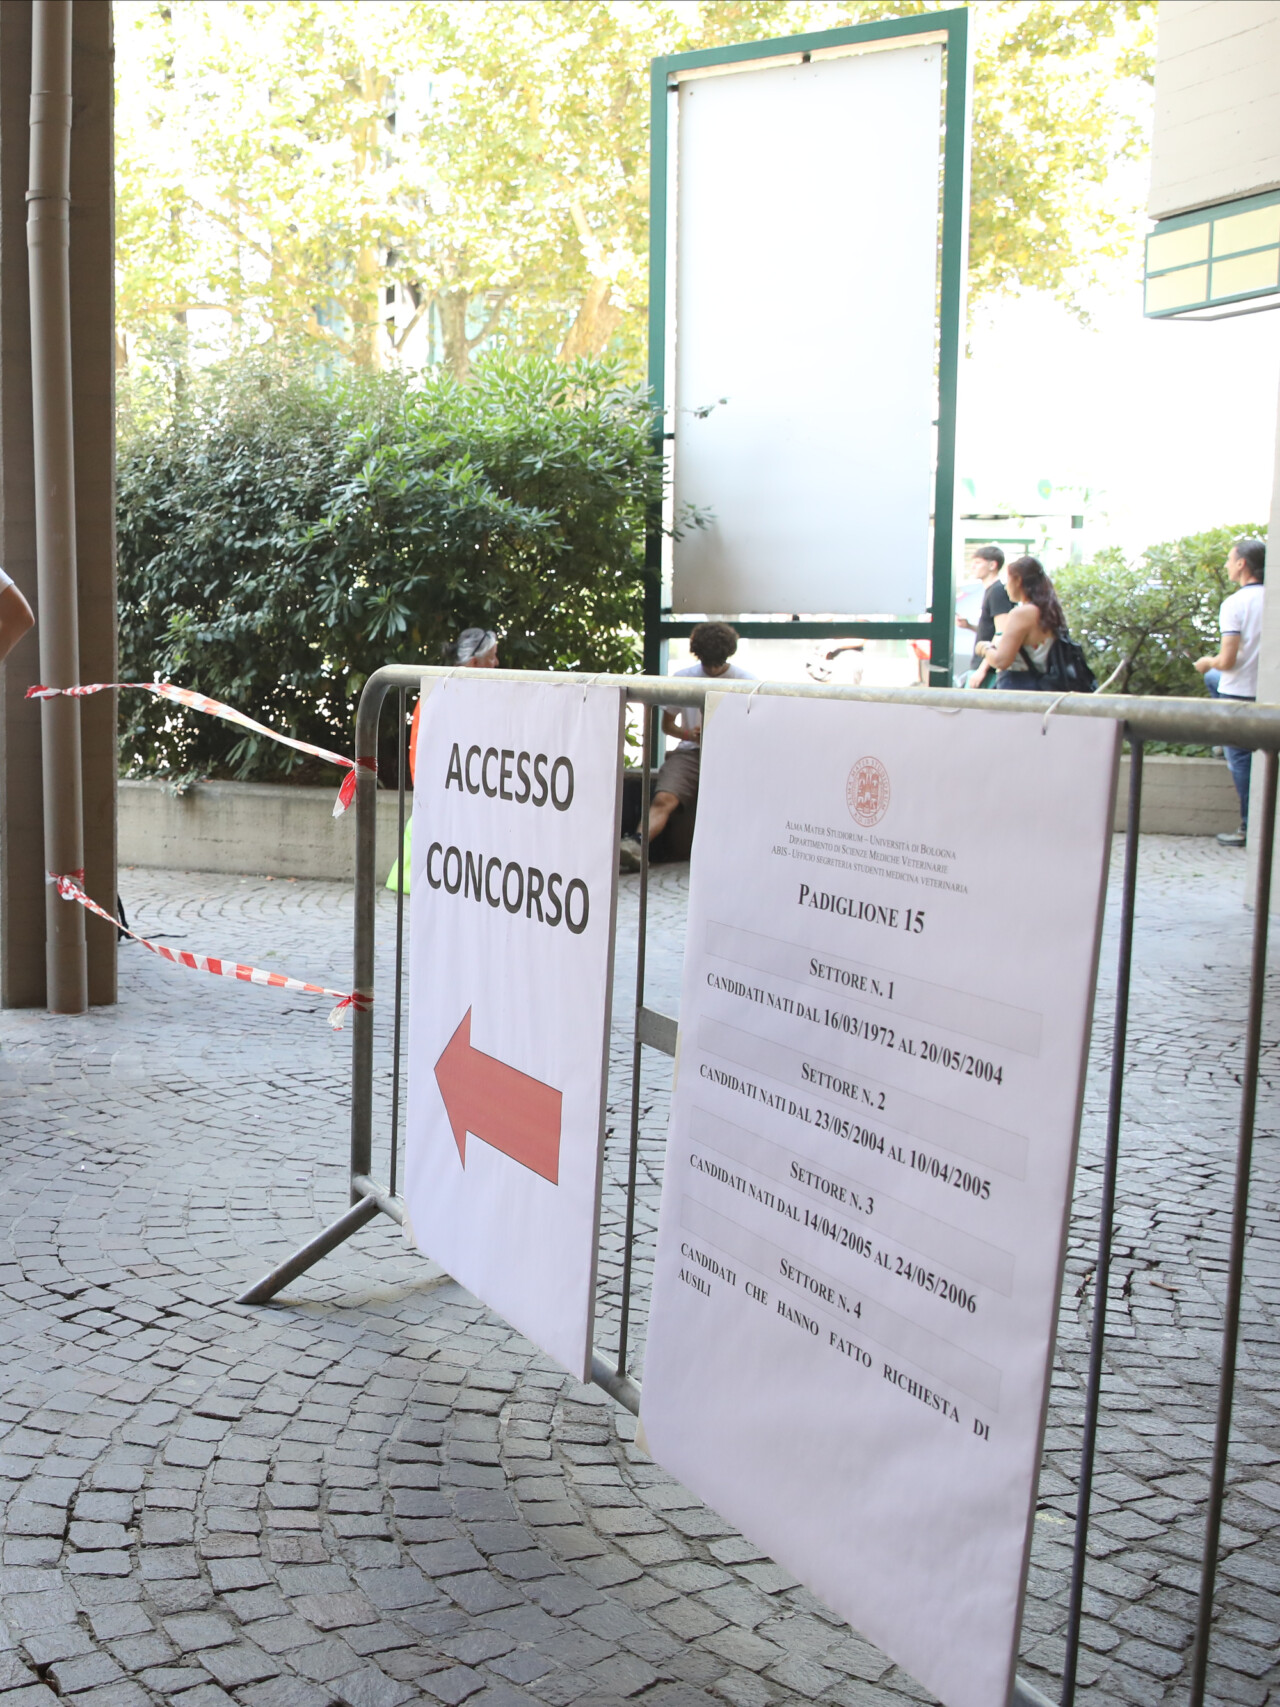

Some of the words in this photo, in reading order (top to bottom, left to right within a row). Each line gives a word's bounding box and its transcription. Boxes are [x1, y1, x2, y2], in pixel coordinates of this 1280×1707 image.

[445, 743, 574, 811] ACCESSO
[785, 821, 802, 831] ALMA
[804, 824, 825, 835] MATER
[827, 828, 863, 843] STUDIORUM
[870, 835, 909, 852] UNIVERSITÀ
[911, 844, 918, 853] DI
[920, 844, 956, 860] BOLOGNA
[789, 835, 833, 851] DIPARTIMENTO
[834, 845, 840, 853] DI
[841, 845, 867, 858] SCIENZE
[869, 850, 899, 864] MEDICHE
[901, 854, 948, 874] VETERINARIE
[427, 842, 589, 934] CONCORSO
[771, 846, 787, 856] ABIS
[792, 849, 815, 862] UFFICIO
[816, 856, 852, 870] SEGRETERIA
[854, 864, 884, 876] STUDENTI
[886, 870, 918, 884] MEDICINA
[921, 877, 968, 894] VETERINARIA
[798, 883, 899, 929] PADIGLIONE
[903, 909, 925, 934] 15
[809, 958, 868, 992] SETTORE
[871, 978, 883, 997] N.
[888, 981, 895, 999] 1
[707, 973, 764, 1004] CANDIDATI
[767, 991, 794, 1013] NATI
[797, 1002, 820, 1024] DAL
[823, 1008, 895, 1048] 16/03/1972
[899, 1037, 917, 1056] AL
[920, 1040, 1003, 1083] 20/05/2004
[801, 1062, 859, 1100] SETTORE
[862, 1087, 874, 1106] N.
[877, 1092, 886, 1111] 2
[699, 1063, 757, 1100] CANDIDATI
[759, 1087, 786, 1112] NATI
[788, 1100, 812, 1123] DAL
[814, 1109, 885, 1155] 23/05/2004
[888, 1144, 905, 1164] AL
[910, 1149, 991, 1200] 10/04/2005
[790, 1160, 847, 1203] SETTORE
[850, 1191, 862, 1211] N.
[865, 1197, 874, 1215] 3
[690, 1153, 747, 1194] CANDIDATI
[748, 1181, 775, 1208] NATI
[777, 1196, 800, 1222] DAL
[803, 1208, 872, 1259] 14/04/2005
[875, 1248, 892, 1270] AL
[895, 1257, 977, 1314] 24/05/2006
[678, 1268, 712, 1298] AUSILI
[779, 1258, 835, 1304] SETTORE
[838, 1293, 850, 1313] N.
[853, 1300, 862, 1319] 4
[680, 1242, 736, 1286] CANDIDATI
[745, 1281, 768, 1305] CHE
[777, 1300, 819, 1336] HANNO
[829, 1331, 872, 1368] FATTO
[883, 1364, 960, 1423] RICHIESTA
[973, 1417, 990, 1442] DI
